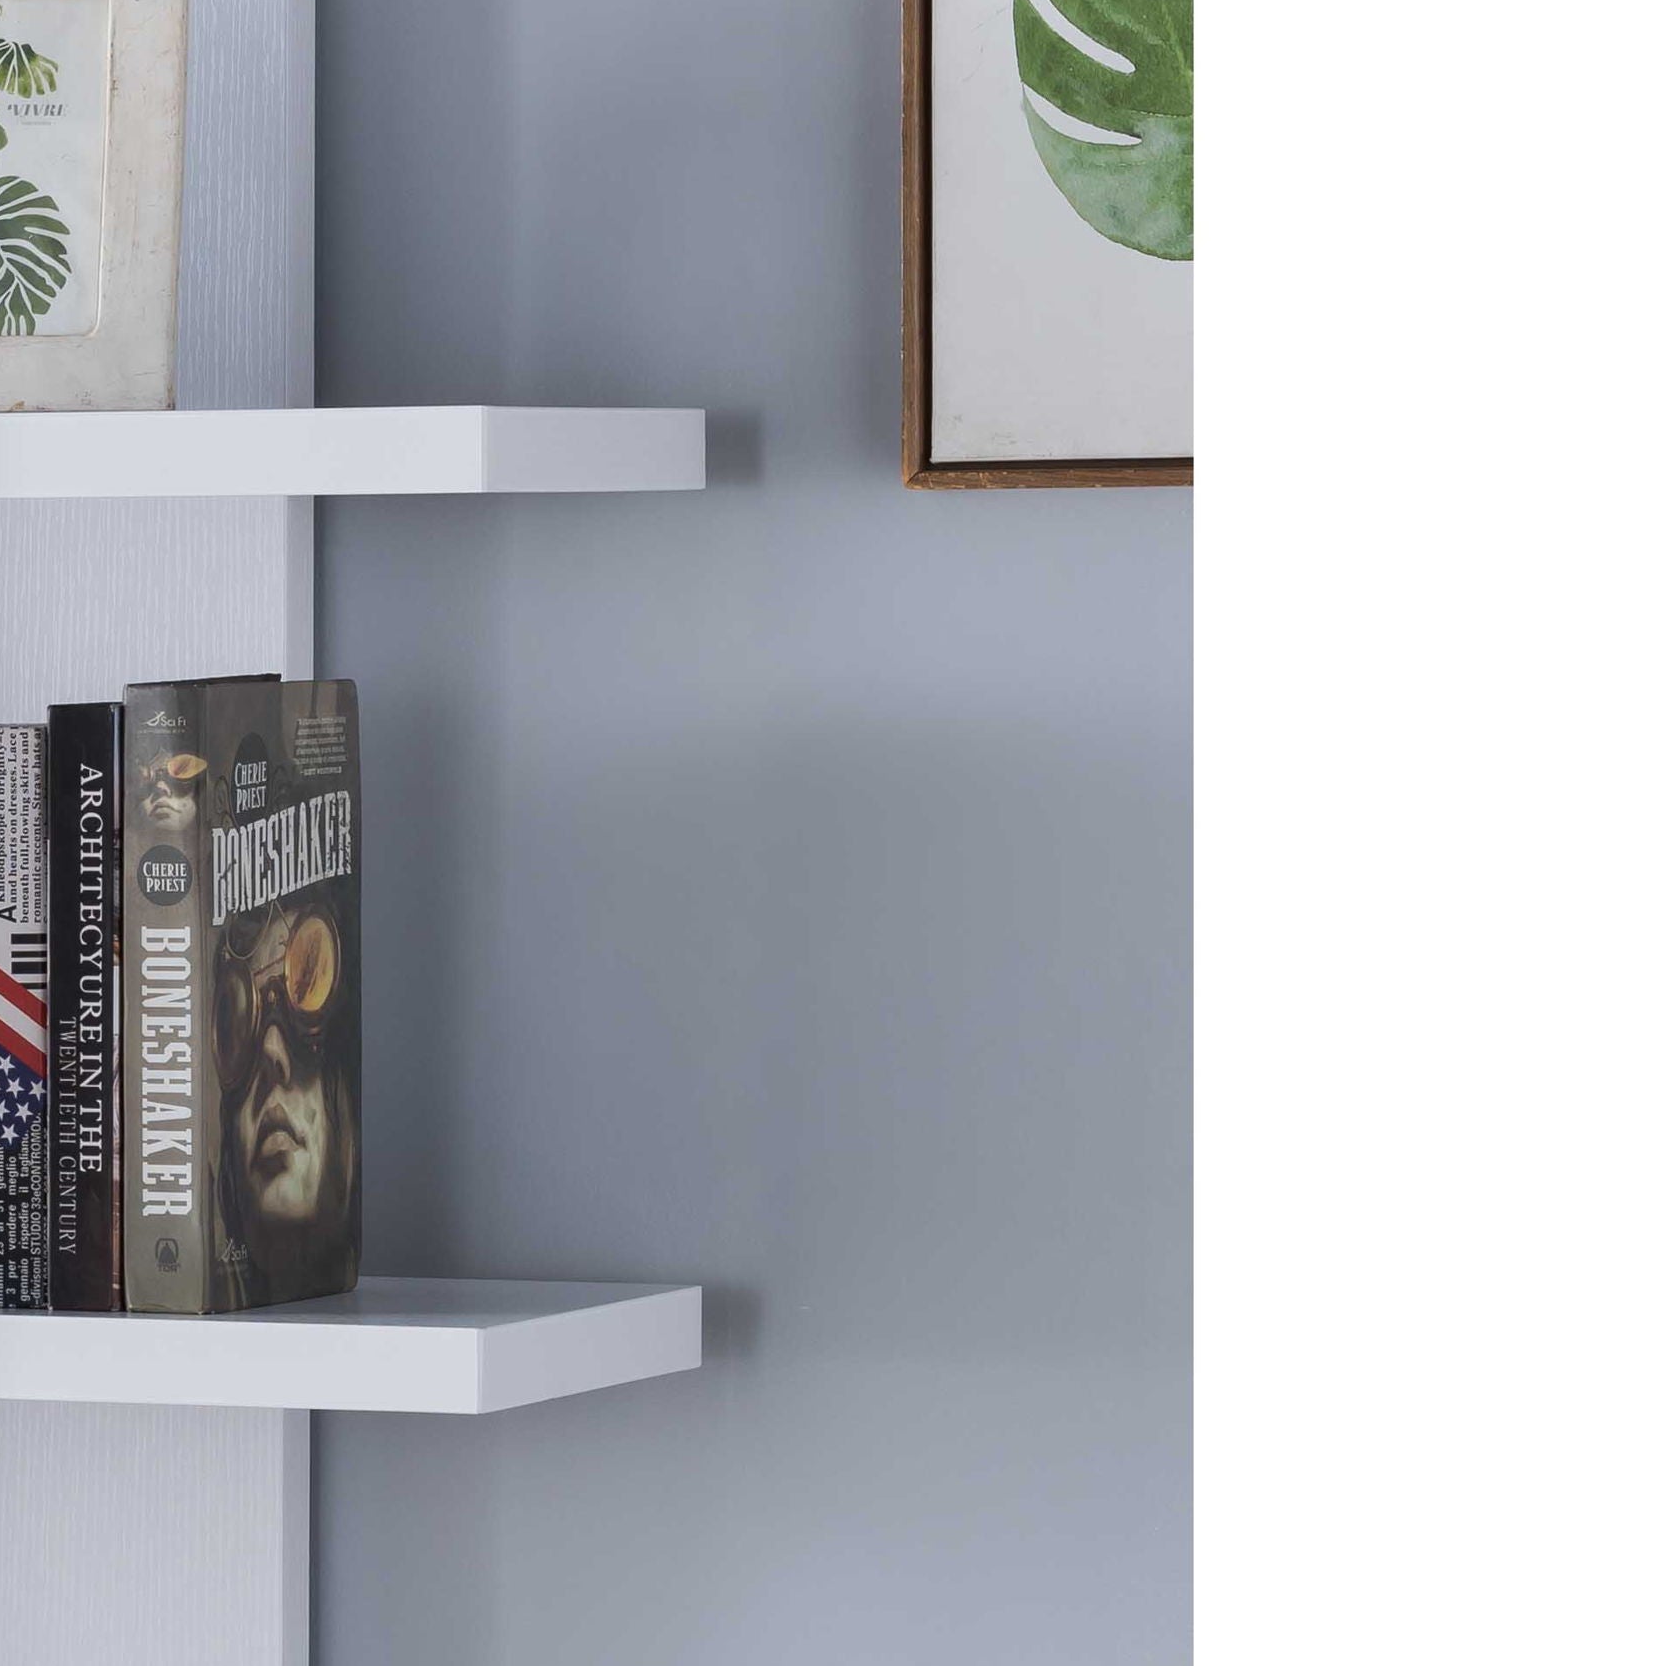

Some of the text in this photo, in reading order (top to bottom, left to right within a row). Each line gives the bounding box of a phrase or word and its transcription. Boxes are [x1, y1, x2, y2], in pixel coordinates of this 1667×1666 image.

[19, 732, 29, 755] and
[31, 741, 42, 769] hats
[20, 757, 29, 795] skirts
[31, 772, 42, 810] Straw
[234, 761, 267, 787] CHERIE
[7, 732, 17, 904] and hearts on dresses. Lace
[236, 786, 267, 813] PRIEST
[142, 861, 187, 878] CHERIE
[211, 790, 352, 926] BONESHAKER
[20, 874, 29, 924] beneath
[32, 865, 42, 923] romantic
[146, 877, 187, 893] PRIEST
[79, 763, 104, 1173] ARCHITECYURE IN THE
[140, 926, 193, 1217] BONESHAKER
[58, 1016, 77, 1255] TWENTIETH CENTURY
[6, 1156, 19, 1196] meglio
[18, 1186, 29, 1194] il
[5, 1204, 17, 1251] vendere
[18, 1202, 31, 1250] rispedire
[30, 1211, 41, 1255] STUDIO
[8, 1259, 19, 1279] per
[18, 1258, 31, 1302] gennaio
